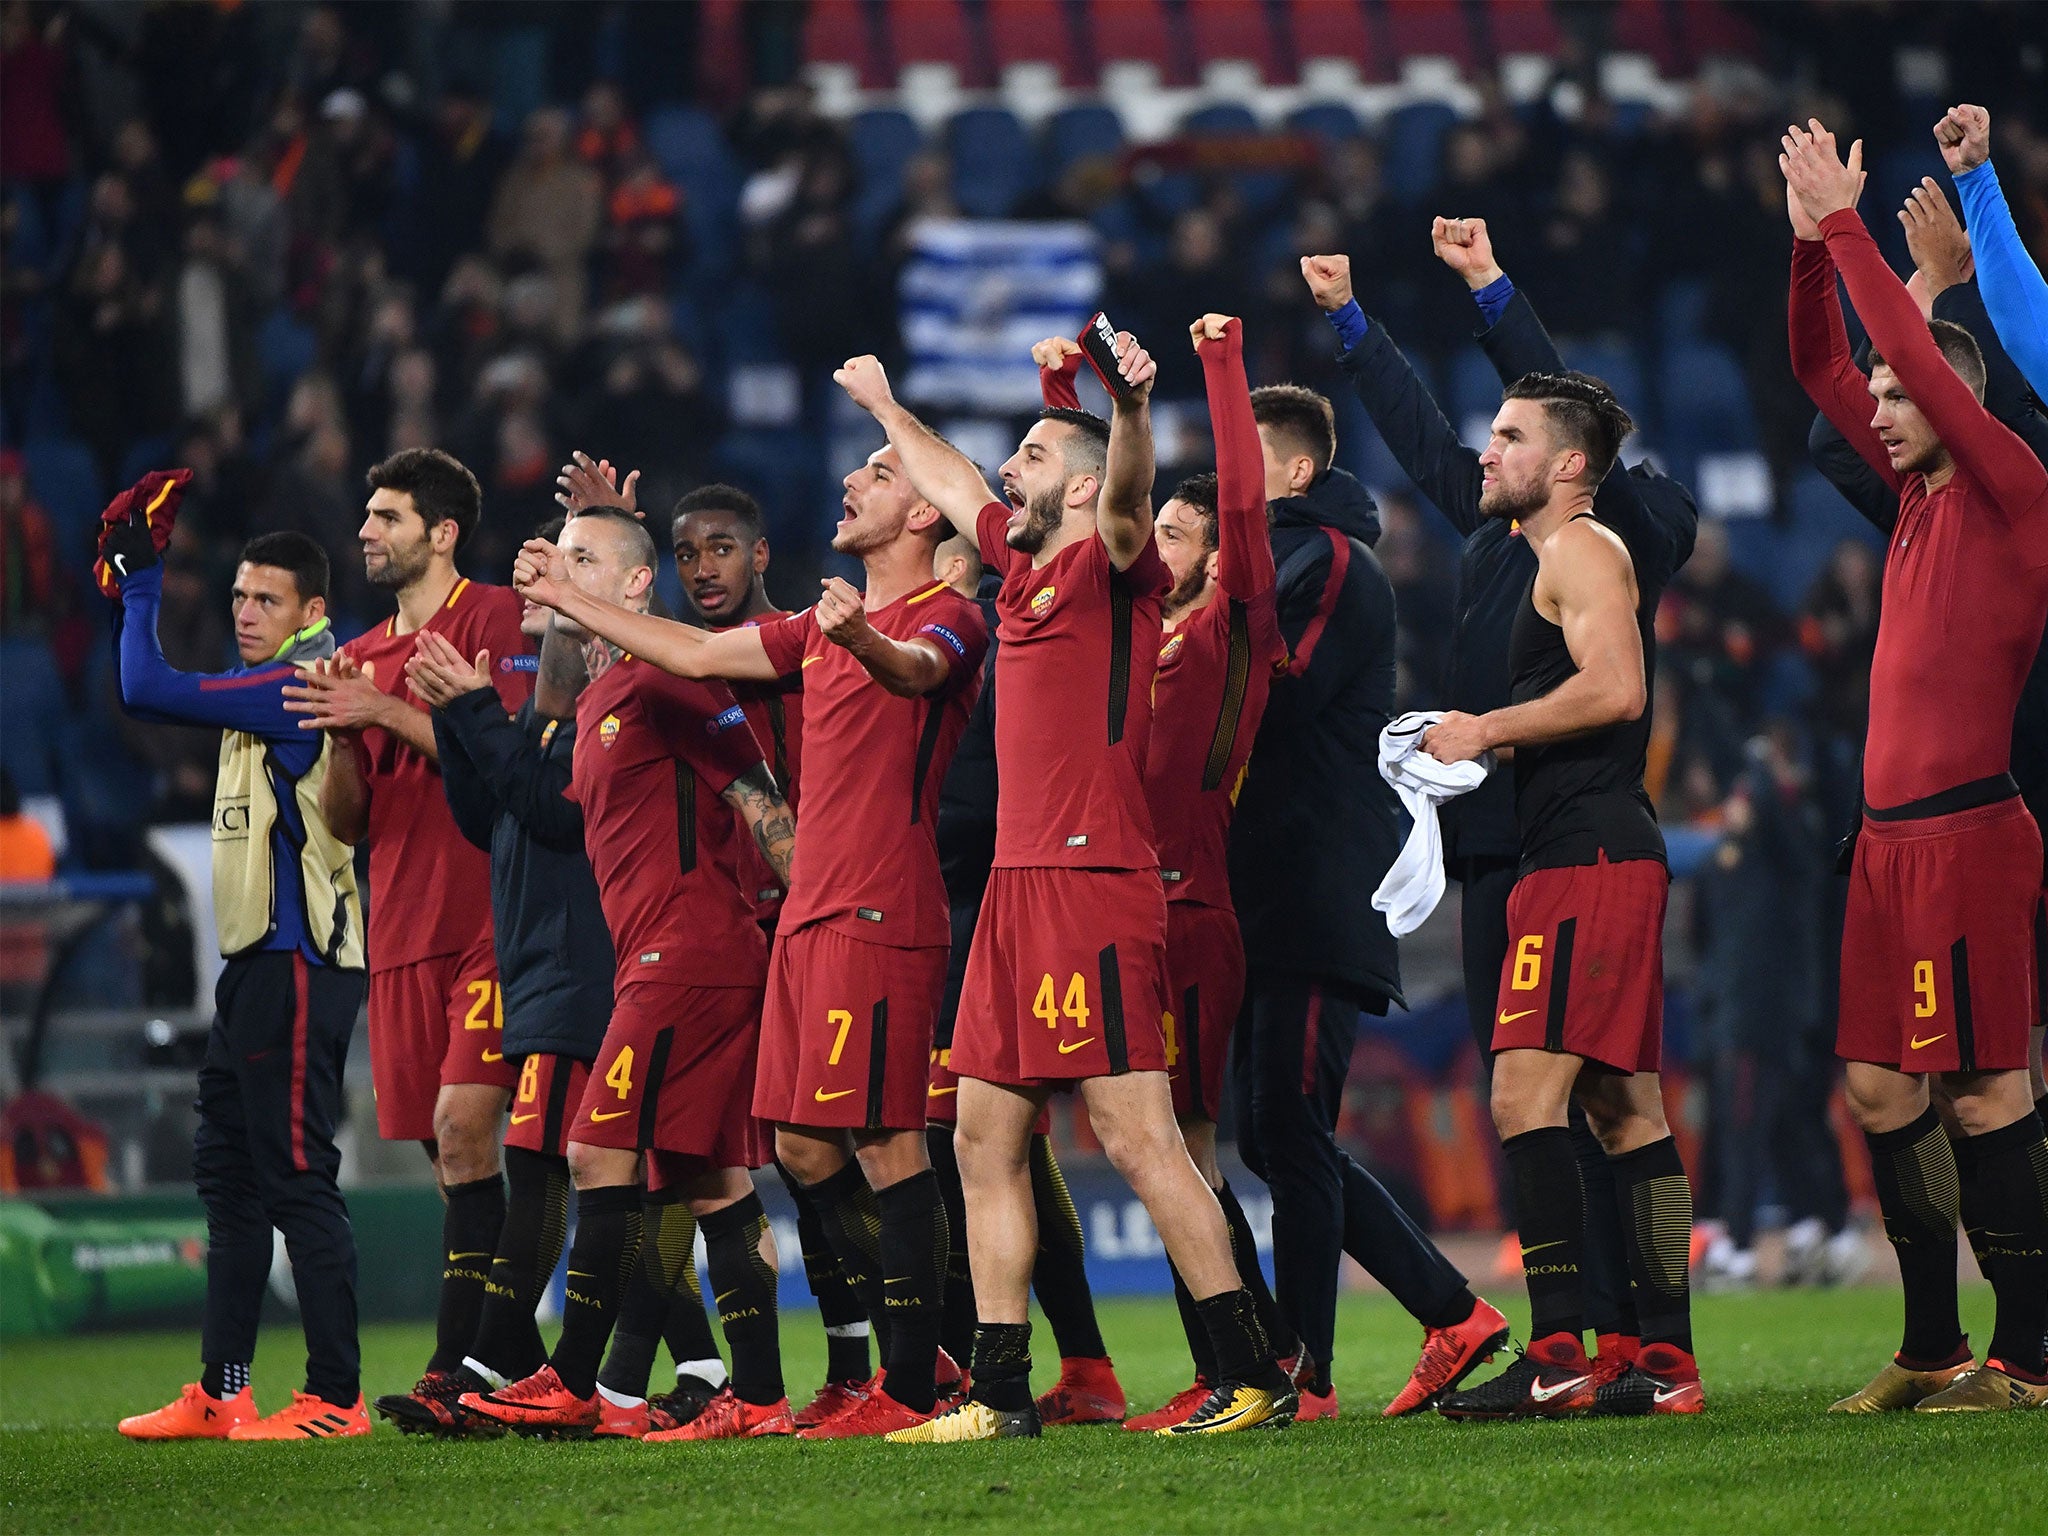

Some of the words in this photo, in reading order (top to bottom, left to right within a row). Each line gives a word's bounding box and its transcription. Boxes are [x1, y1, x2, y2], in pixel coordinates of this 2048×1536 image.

[934, 626, 965, 654] RESPECT
[1511, 934, 1544, 991] 6
[1913, 960, 1937, 1018] 9
[1032, 972, 1090, 1029] 44
[828, 1009, 853, 1065] 7
[518, 1053, 540, 1103] 8
[605, 1045, 635, 1100] 4
